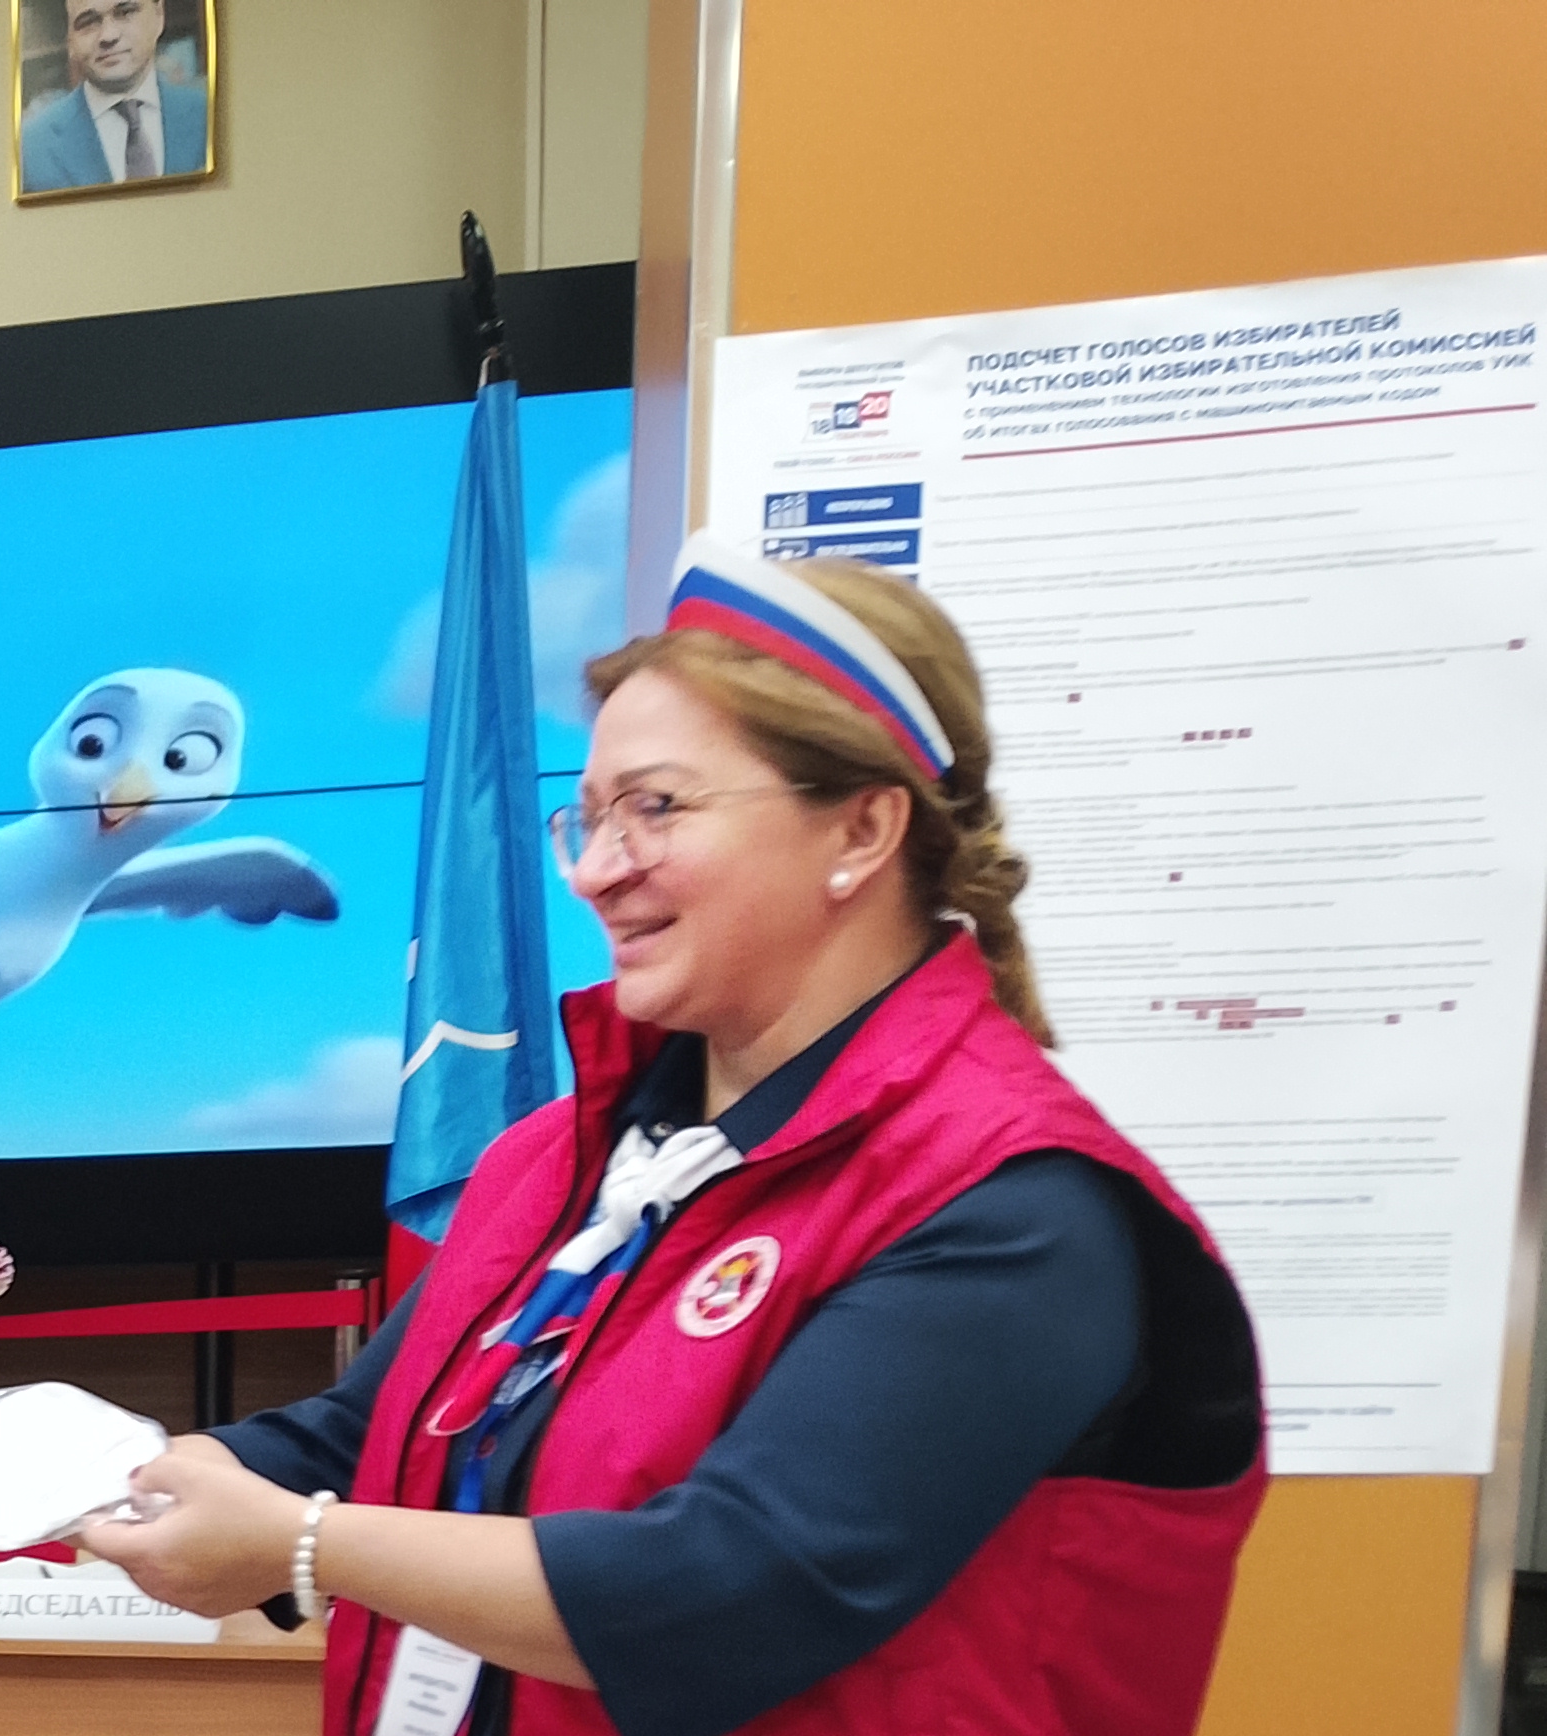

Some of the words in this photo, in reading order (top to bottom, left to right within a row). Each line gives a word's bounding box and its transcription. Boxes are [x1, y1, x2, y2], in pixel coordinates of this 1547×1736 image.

[967, 345, 1080, 373] ПОДСЧЕТ
[1086, 333, 1207, 361] ГОЛОСОВ
[1213, 307, 1401, 348] ИЗБИРАТЕЛЕЙ
[967, 363, 1132, 398] УЧАСТКОВОЙ
[1138, 340, 1362, 383] ИЗБИРАТЕЛЬНОЙ
[1368, 322, 1537, 359] КОМИССИЕЙ
[1111, 385, 1219, 406] технологии
[1367, 360, 1484, 383] протоколов
